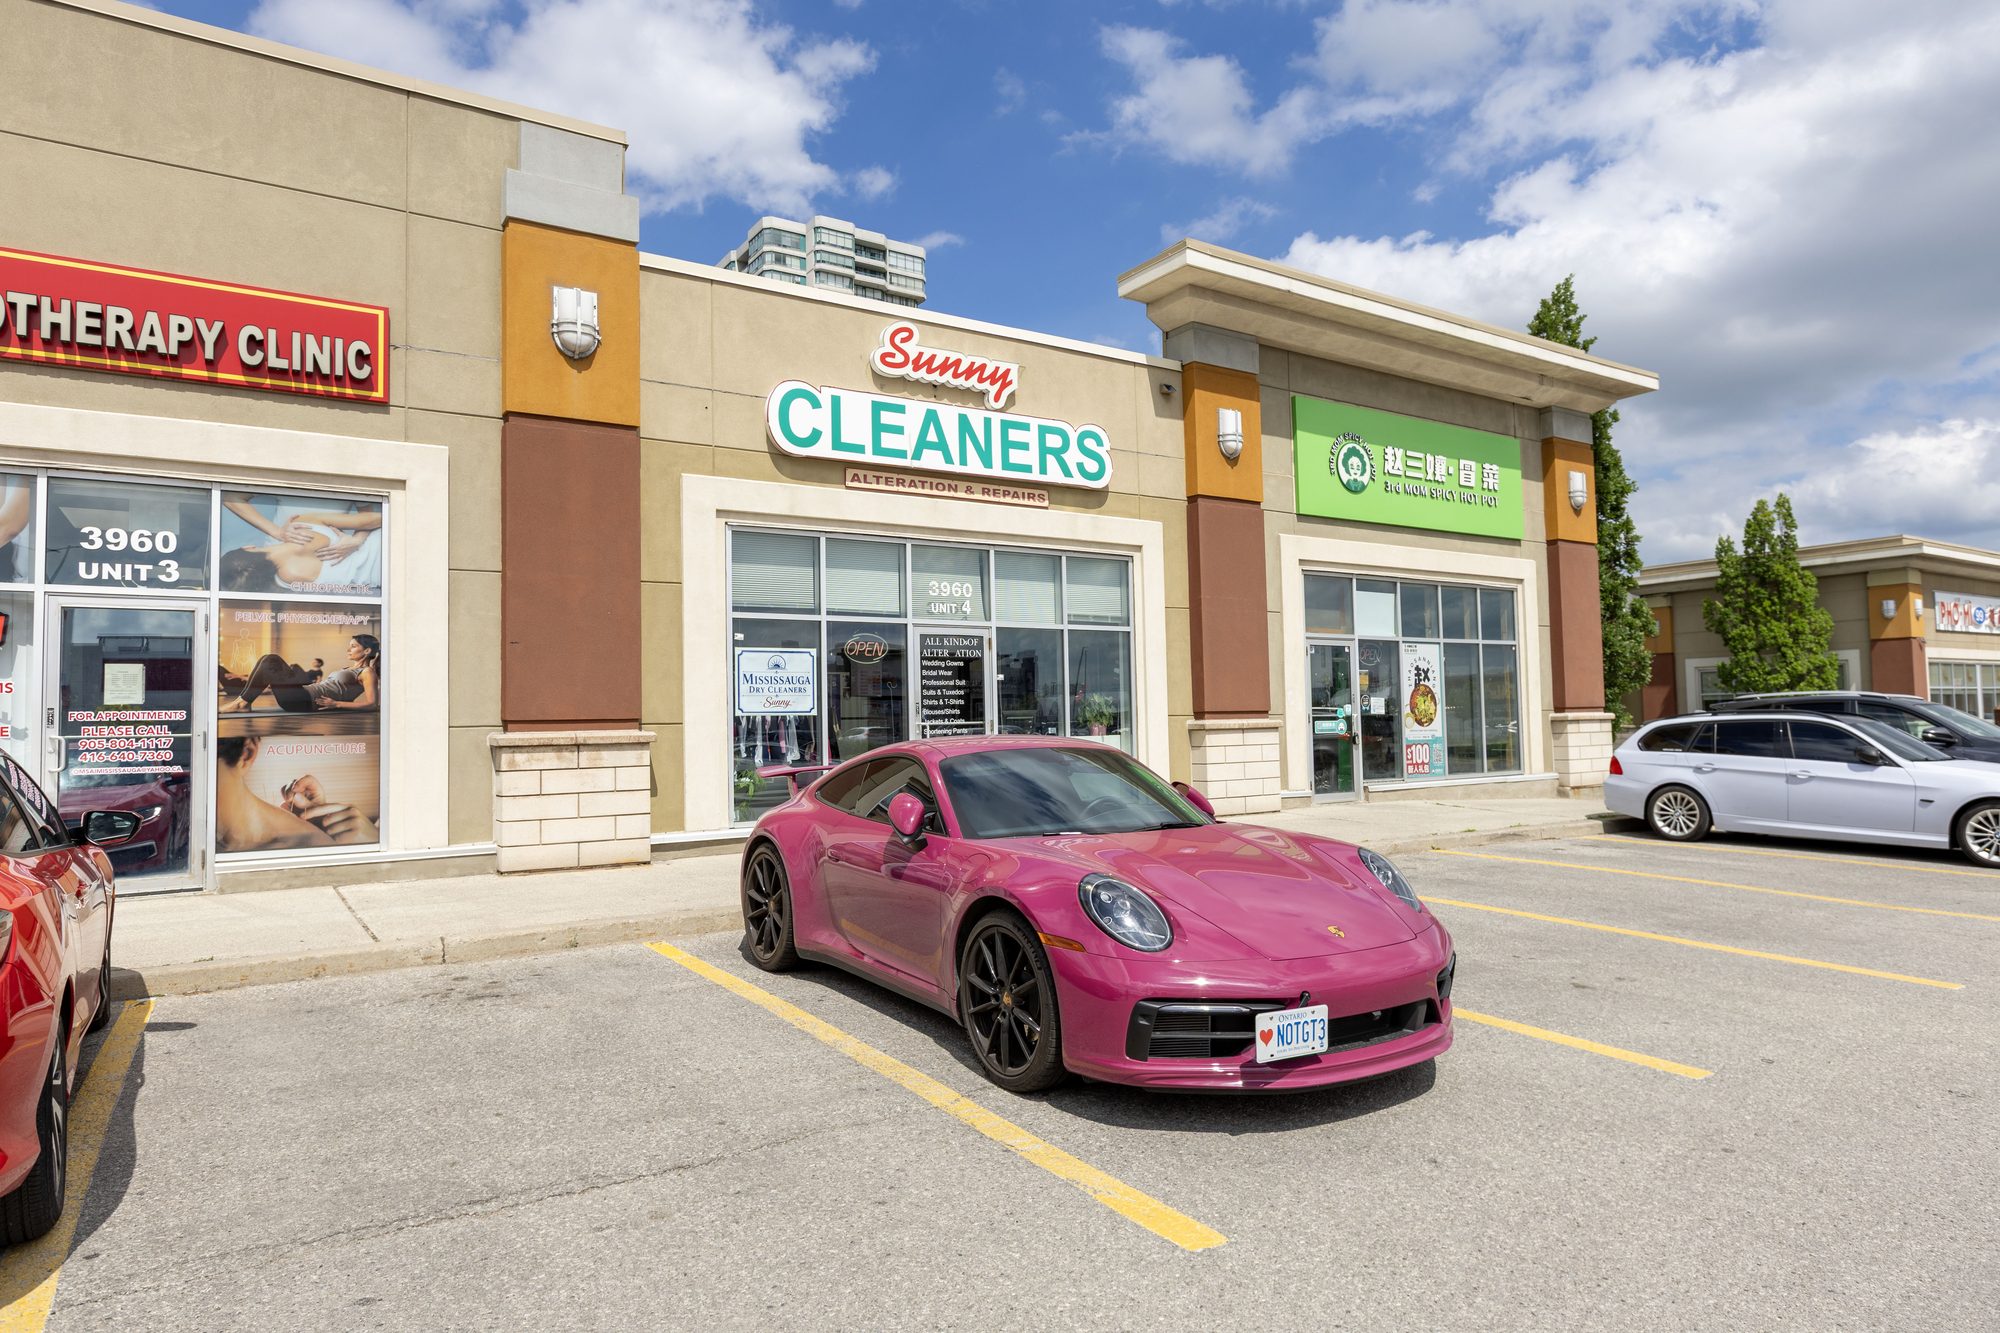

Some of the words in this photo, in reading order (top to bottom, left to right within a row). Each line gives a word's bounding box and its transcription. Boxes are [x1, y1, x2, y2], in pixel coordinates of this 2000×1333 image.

[0, 290, 224, 360] THERAPY
[238, 325, 372, 380] CLINIC
[879, 326, 1013, 403] Sunny
[778, 387, 1107, 482] CLEANERS
[1344, 432, 1364, 443] SPICY
[850, 473, 958, 493] ALTERATION
[964, 485, 975, 495] &
[981, 487, 1046, 503] REPAIRS
[1384, 480, 1401, 493] 3rd
[1404, 483, 1427, 496] MOM
[1430, 487, 1456, 501] SPICY
[1460, 491, 1478, 504] HOT
[1482, 495, 1499, 507] POT
[80, 526, 178, 554] 3960
[78, 561, 153, 581] UNIT
[157, 559, 180, 583] 3
[290, 580, 373, 595] CHIROPRACTIC
[928, 580, 973, 598] 3960
[931, 602, 957, 614] UNIT
[961, 600, 971, 615] 4
[235, 611, 276, 623] PELVIC
[277, 612, 370, 625] PHYSIOTHERAPY
[846, 641, 885, 656] OPEN
[924, 637, 942, 646] ALL
[967, 638, 979, 647] OF
[921, 660, 945, 668] Wedding
[742, 673, 811, 685] MISSISSAUGA
[749, 685, 765, 693] DRY
[767, 685, 807, 693] CLEANERS
[763, 696, 791, 709] Sunny
[68, 711, 93, 721] FOR
[96, 710, 186, 721] APPOINTMENTS
[81, 726, 133, 736] PLEASE
[136, 725, 171, 736] CALL
[78, 738, 174, 750] 905-804-1117
[266, 742, 366, 757] ACUPUNCTURE
[79, 751, 173, 763] 416-640-7360
[1407, 743, 1430, 764] $100
[1278, 1012, 1307, 1022] ONTARIO
[1277, 1018, 1326, 1047] NOTGT3
